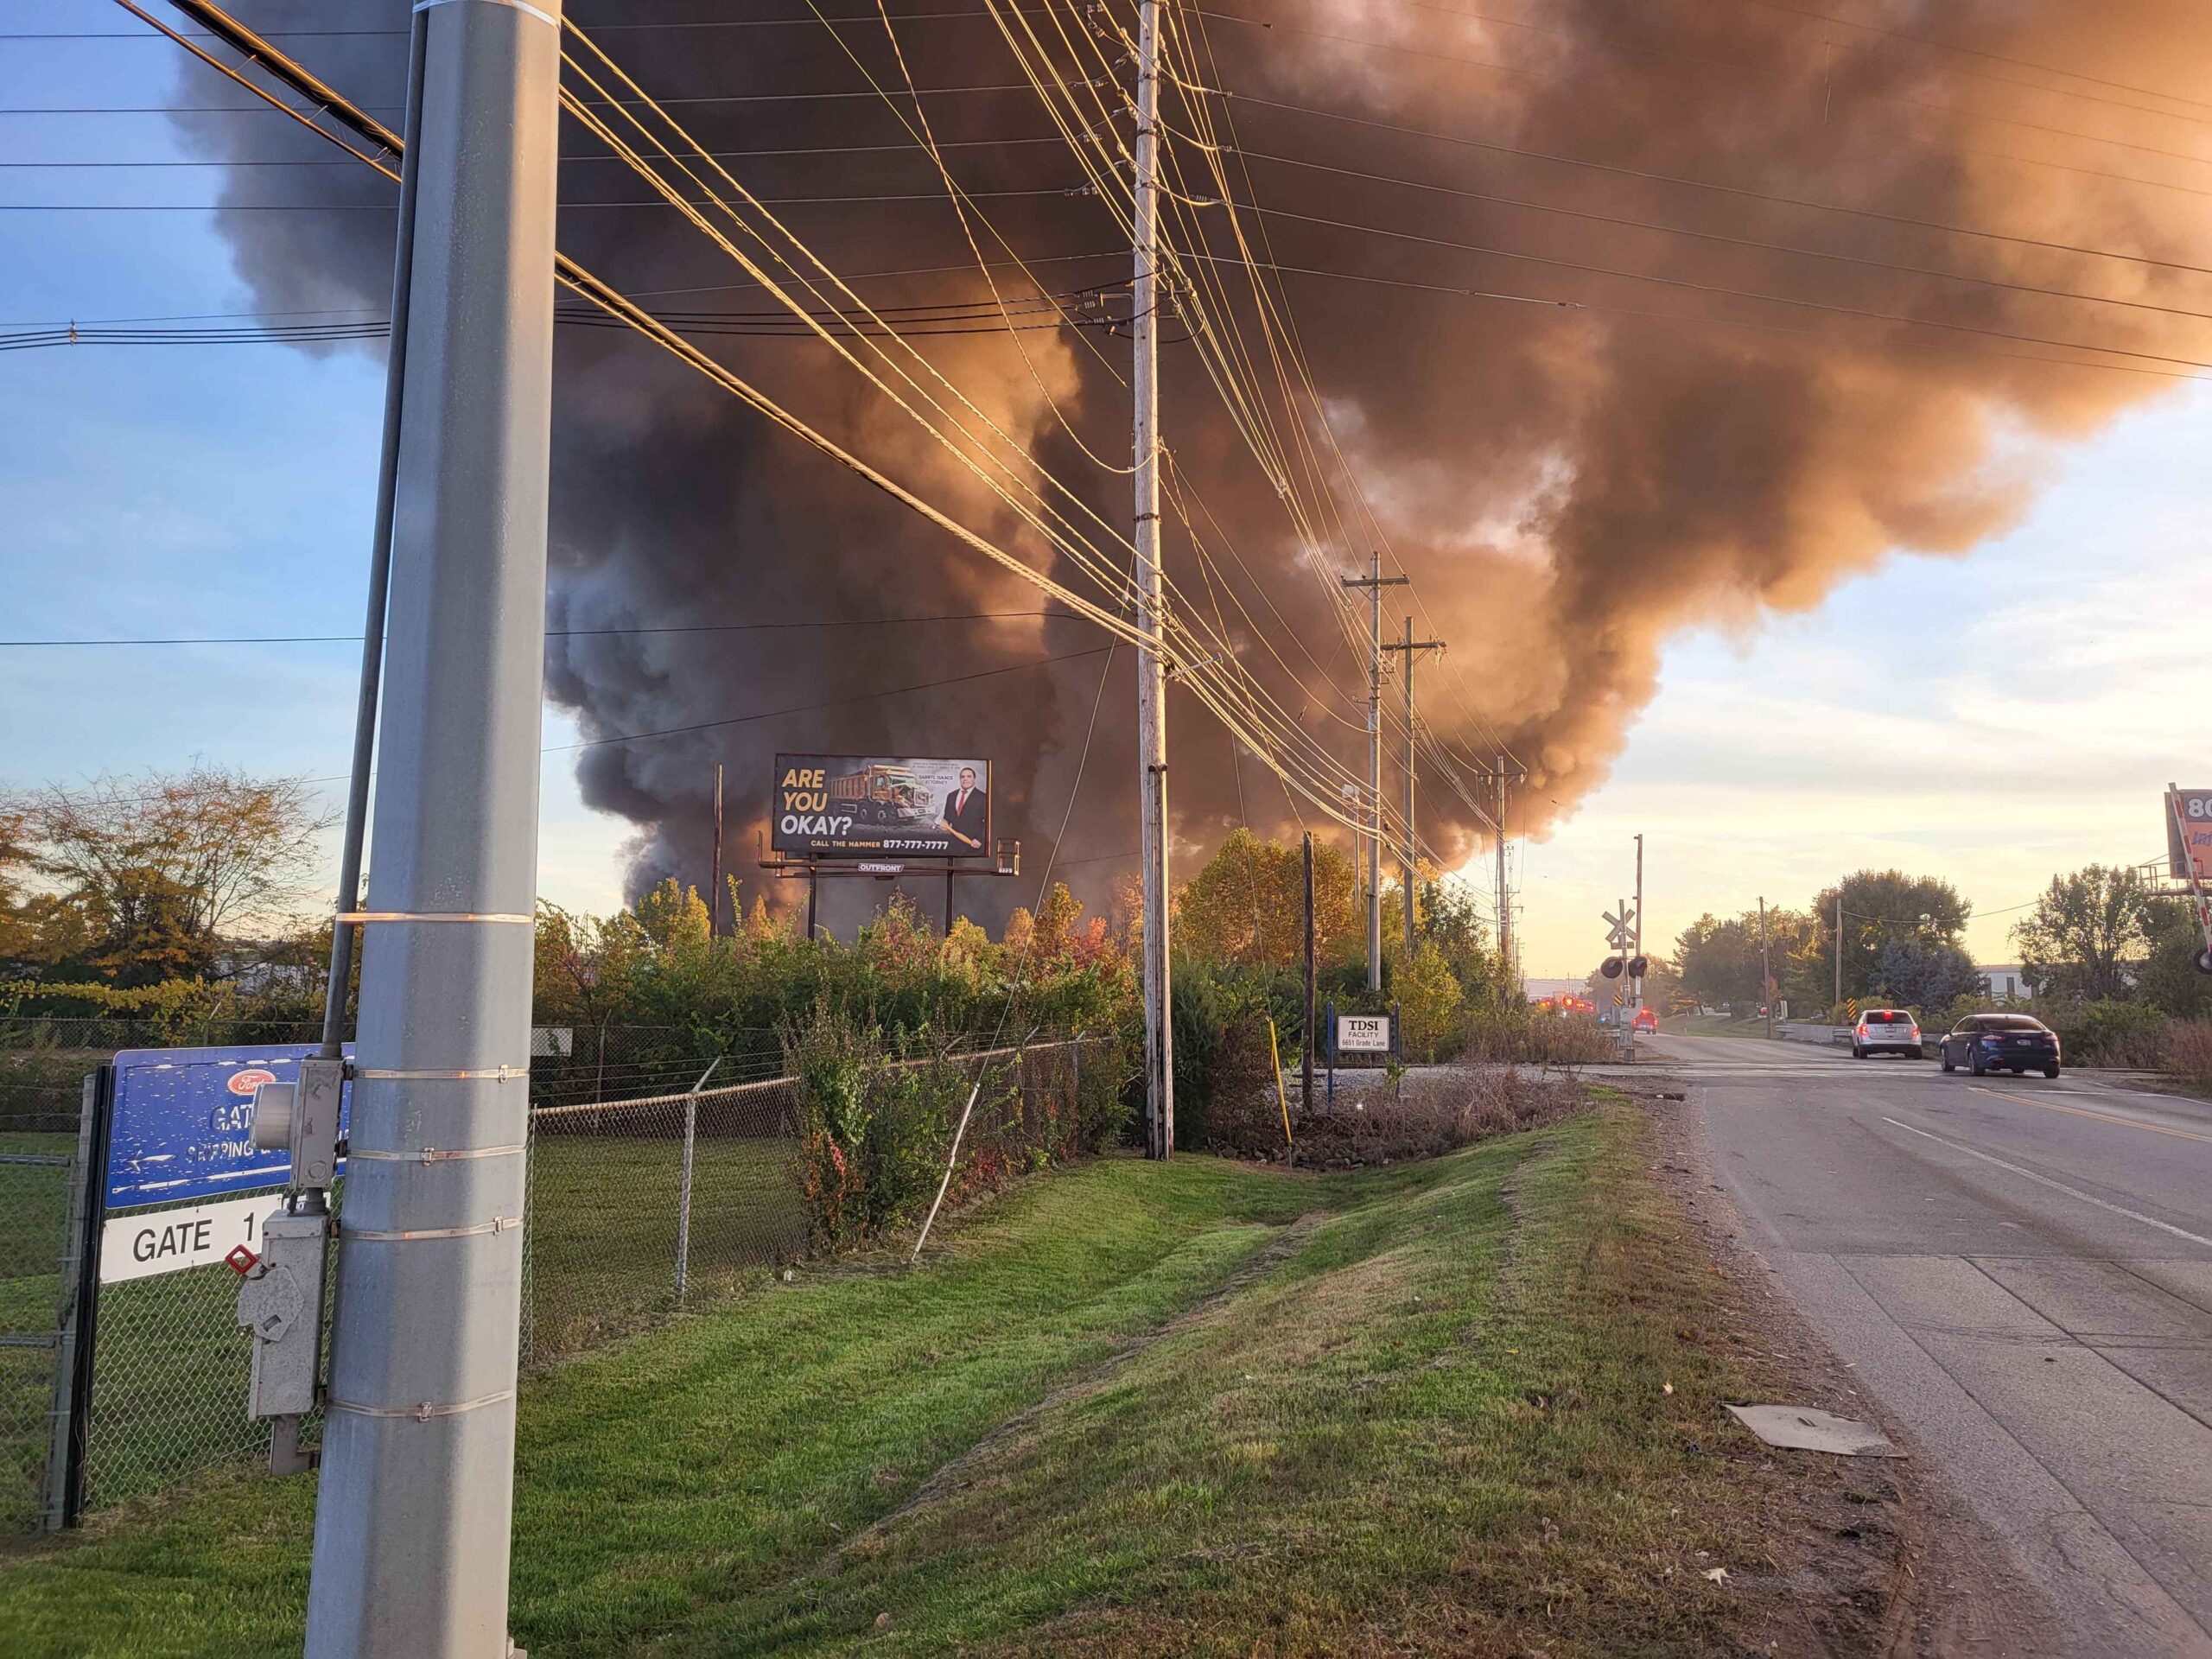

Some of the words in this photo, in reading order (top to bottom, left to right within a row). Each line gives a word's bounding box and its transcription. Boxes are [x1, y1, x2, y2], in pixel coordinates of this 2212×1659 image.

[781, 768, 825, 788] ARE
[784, 791, 828, 811] YOU
[780, 815, 853, 836] OKAY?
[883, 840, 949, 849] 877-777-7777
[1349, 1020, 1379, 1031] TDSI
[210, 1104, 252, 1131] GAT
[133, 1218, 213, 1262] GATE
[243, 1212, 255, 1242] 1
